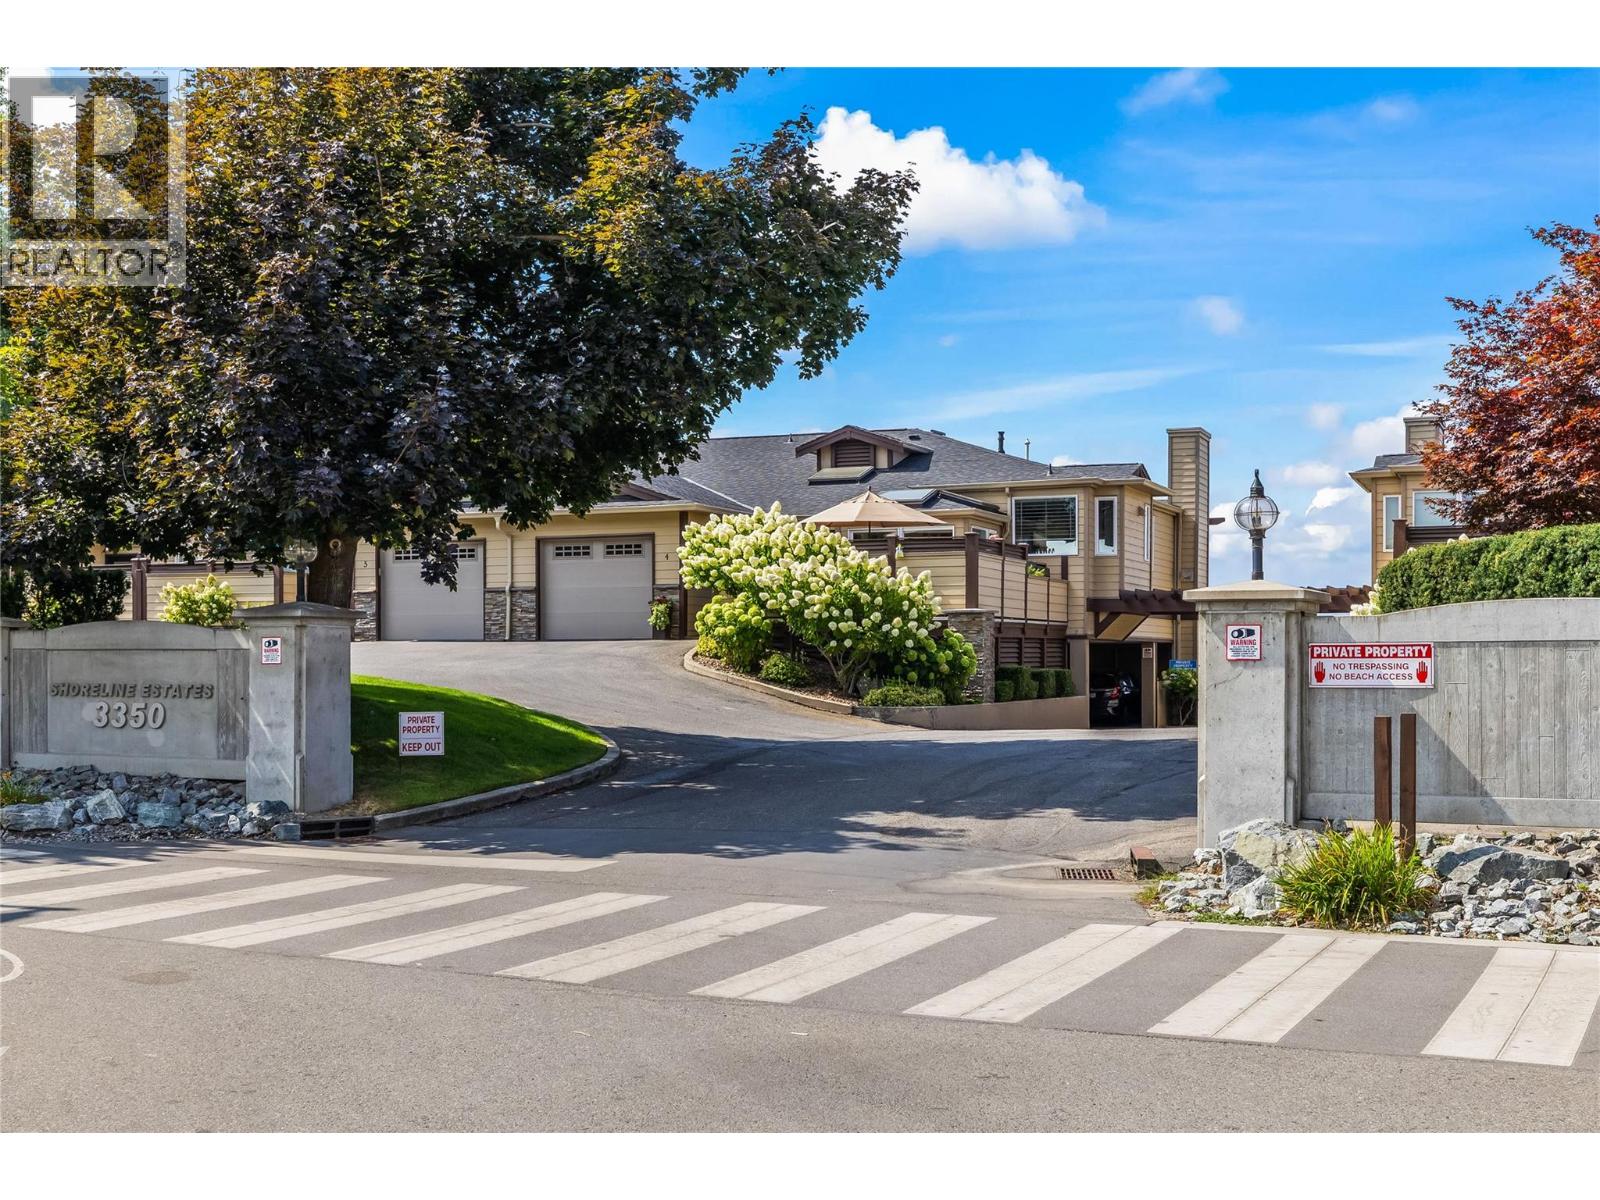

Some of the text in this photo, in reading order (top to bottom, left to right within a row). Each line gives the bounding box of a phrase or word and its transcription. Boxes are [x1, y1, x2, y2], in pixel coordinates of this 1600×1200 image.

[1313, 645, 1428, 657] PRIVATE PROPERTY
[1332, 662, 1409, 671] NO TRESPASSING
[1328, 673, 1413, 681] NO BEACH ACCESS
[50, 682, 214, 699] SHORELINE ESTATES
[93, 701, 166, 729] 3350
[407, 716, 436, 724] PRIVATE
[402, 725, 440, 734] PROPERTY
[402, 742, 441, 752] KEEP OUT
